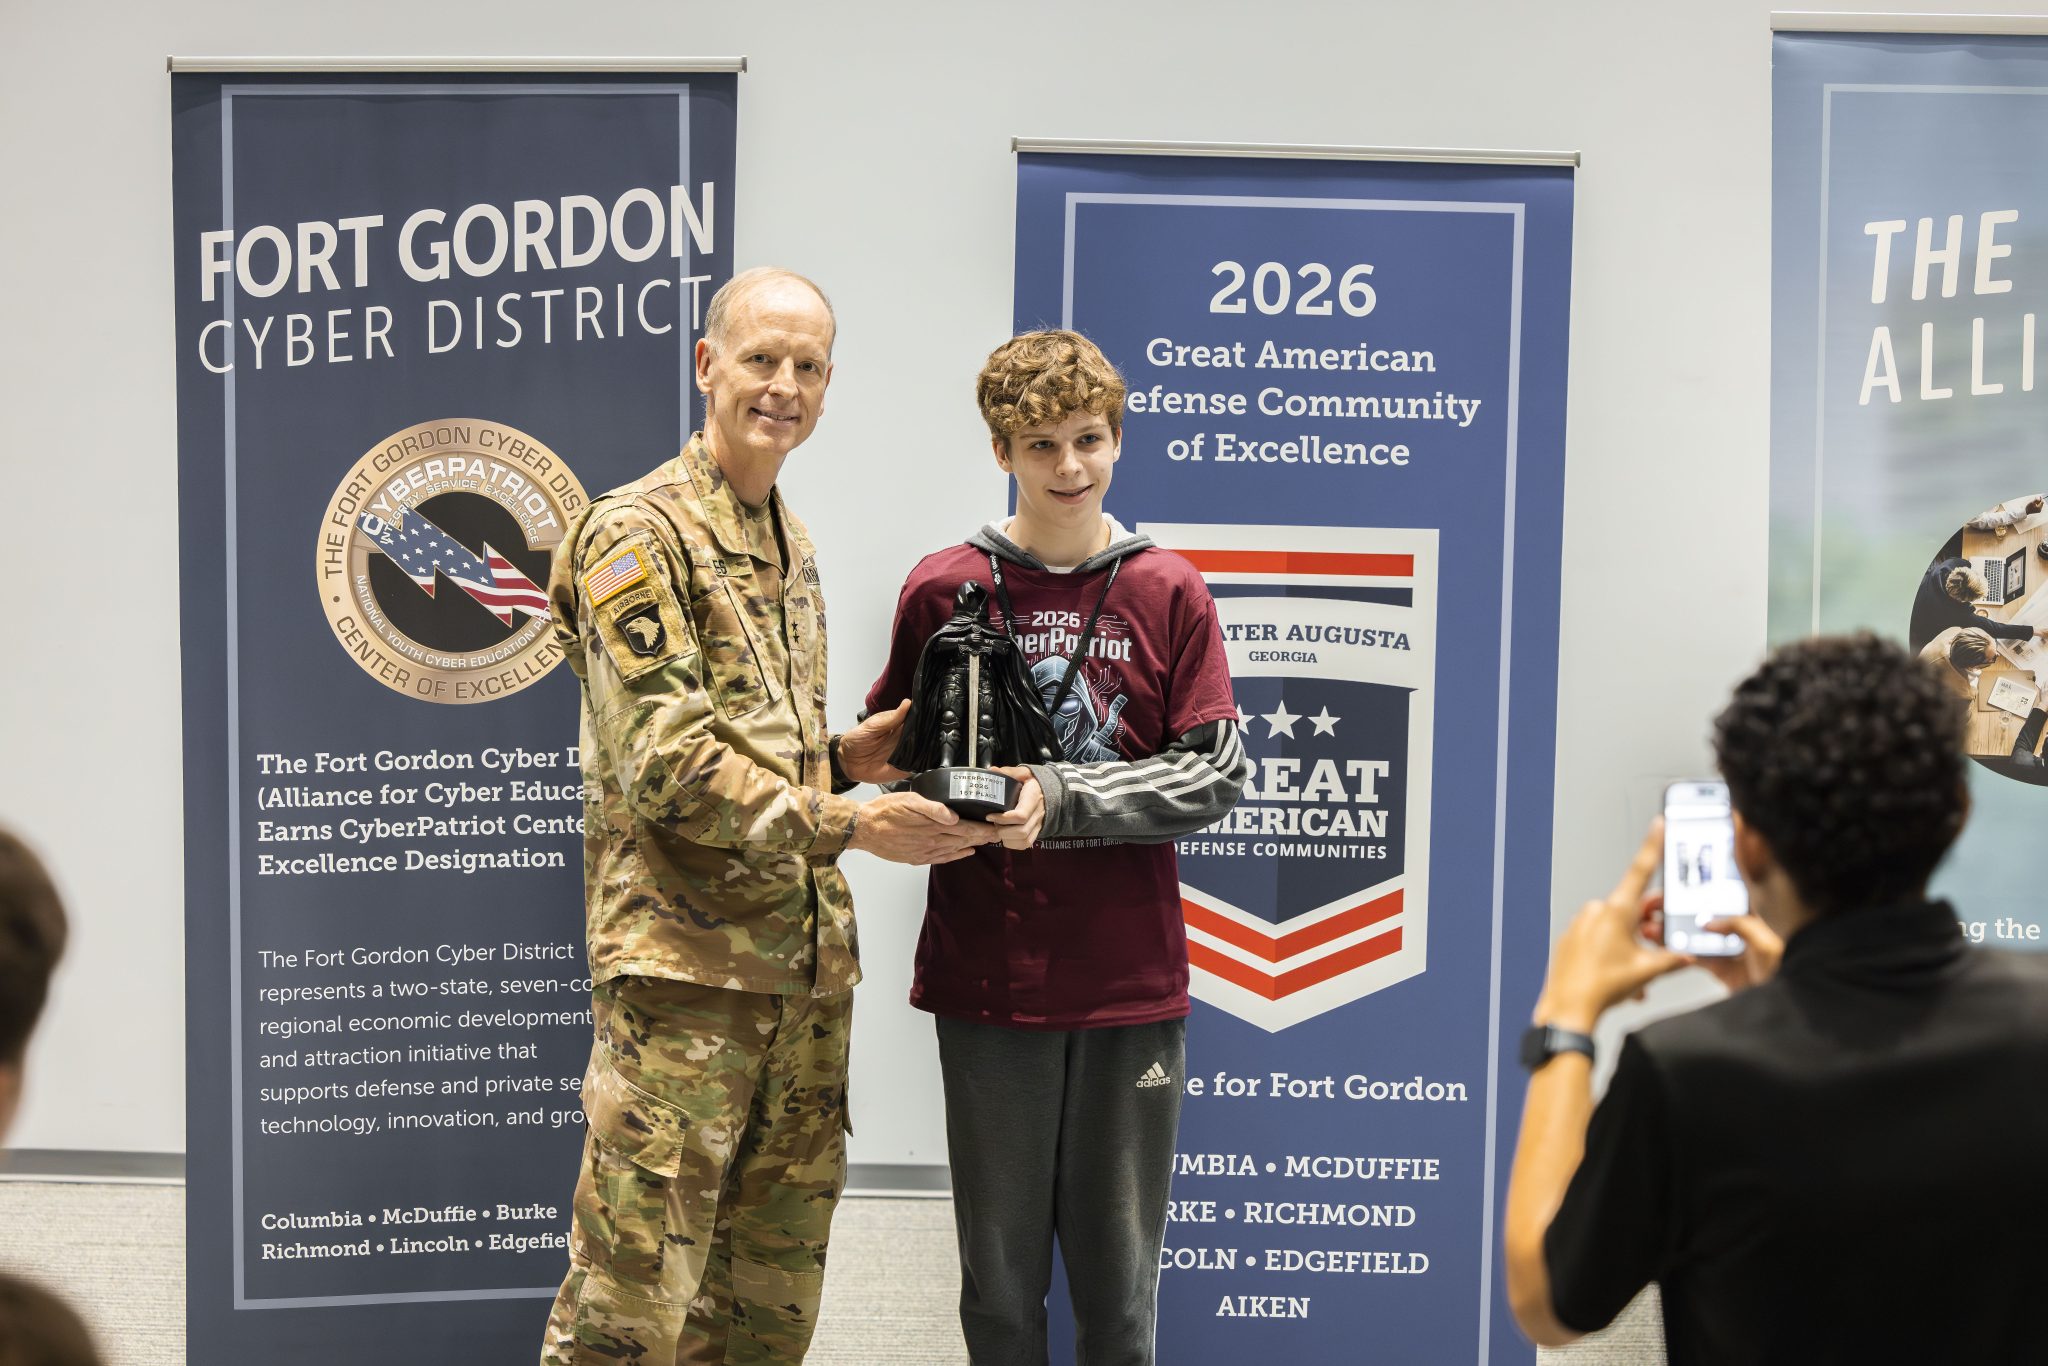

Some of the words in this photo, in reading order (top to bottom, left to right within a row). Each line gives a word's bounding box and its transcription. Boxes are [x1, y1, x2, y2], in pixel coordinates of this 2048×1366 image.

[201, 215, 383, 301] FORT
[399, 182, 714, 282] GORDON
[1864, 210, 2019, 303] THE
[1209, 260, 1377, 318] 2026
[199, 305, 394, 373] CYBER
[428, 275, 712, 353] DISTRICT
[1146, 337, 1246, 368] Great
[1254, 340, 1437, 373] American
[1859, 313, 2035, 406] ALLI
[1127, 385, 1247, 416] efense
[1257, 387, 1482, 428] Community
[372, 427, 470, 473] GORDON
[479, 429, 552, 477] CYBER
[1166, 432, 1205, 461] of
[1214, 433, 1410, 466] Excellence
[333, 469, 373, 531] FORT
[362, 457, 558, 535] CYBERPATRIOT
[485, 484, 540, 544] EXCELLENCE
[325, 534, 343, 579] THE
[613, 591, 651, 615] AIRBORNE
[357, 575, 386, 633] NATIONAL
[387, 631, 424, 661] YOUTH
[425, 654, 466, 668] CYBER
[470, 630, 535, 667] EDUCATION
[1032, 611, 1080, 628] 2026
[1286, 624, 1411, 650] AUGUSTA
[337, 616, 410, 688] CENTER
[416, 678, 447, 698] OF
[455, 635, 565, 699] EXCELLEN
[1249, 651, 1317, 663] GEORGIA
[256, 753, 308, 775] The
[314, 752, 368, 773] Fort
[374, 749, 475, 772] Gordon
[480, 747, 560, 774] Cyber
[257, 786, 373, 811] (Alliance
[379, 783, 419, 805] for
[424, 781, 504, 808] Cyber
[509, 779, 585, 802] Educa
[1243, 758, 1389, 803] REAT
[257, 821, 333, 842] Earns
[339, 815, 507, 844] CyberPatriot
[512, 814, 585, 837] Cente
[1194, 806, 1388, 837] MERICAN
[1041, 840, 1071, 849] ALLIANCE
[1073, 840, 1084, 848] FOR
[1086, 839, 1101, 847] FORT
[1253, 843, 1387, 859] COMMUNITIES
[258, 852, 398, 876] Excellence
[404, 847, 566, 875] Designation
[1994, 917, 2041, 940] the
[257, 950, 298, 969] The
[305, 949, 345, 967] Fort
[351, 946, 429, 966] Gordon
[435, 944, 497, 967] Cyber
[503, 942, 575, 961] District
[259, 982, 366, 1006] represents
[371, 984, 383, 998] a
[389, 978, 493, 997] two-state,
[500, 975, 593, 994] seven-co
[260, 1015, 343, 1039] regional
[348, 1011, 452, 1032] economic
[457, 1008, 594, 1031] development
[259, 1049, 297, 1068] and
[304, 1046, 401, 1067] attraction
[408, 1043, 492, 1063] initiative
[497, 1042, 538, 1060] that
[260, 1082, 349, 1105] supports
[355, 1079, 435, 1098] defense
[441, 1075, 478, 1095] and
[485, 1075, 553, 1097] private
[1136, 1076, 1171, 1088] adidas
[1213, 1071, 1262, 1097] for
[1269, 1072, 1335, 1099] Fort
[1343, 1074, 1468, 1102] Gordon
[260, 1114, 381, 1135] technology,
[388, 1109, 499, 1129] innovation,
[506, 1107, 544, 1125] and
[550, 1110, 585, 1129] gro
[1284, 1155, 1440, 1181] MCDUFFIE
[261, 1210, 364, 1230] Columbia
[381, 1205, 477, 1225] McDuffie
[496, 1203, 558, 1221] Burke
[1165, 1200, 1217, 1224] RKE
[1243, 1201, 1416, 1227] RICHMOND
[261, 1239, 371, 1260] Richmond
[389, 1235, 470, 1255] Lincoln
[488, 1232, 571, 1252] Edgefiel
[1158, 1247, 1238, 1271] COLN
[1264, 1249, 1430, 1274] EDGEFIELD
[1215, 1295, 1311, 1319] AIKEN
